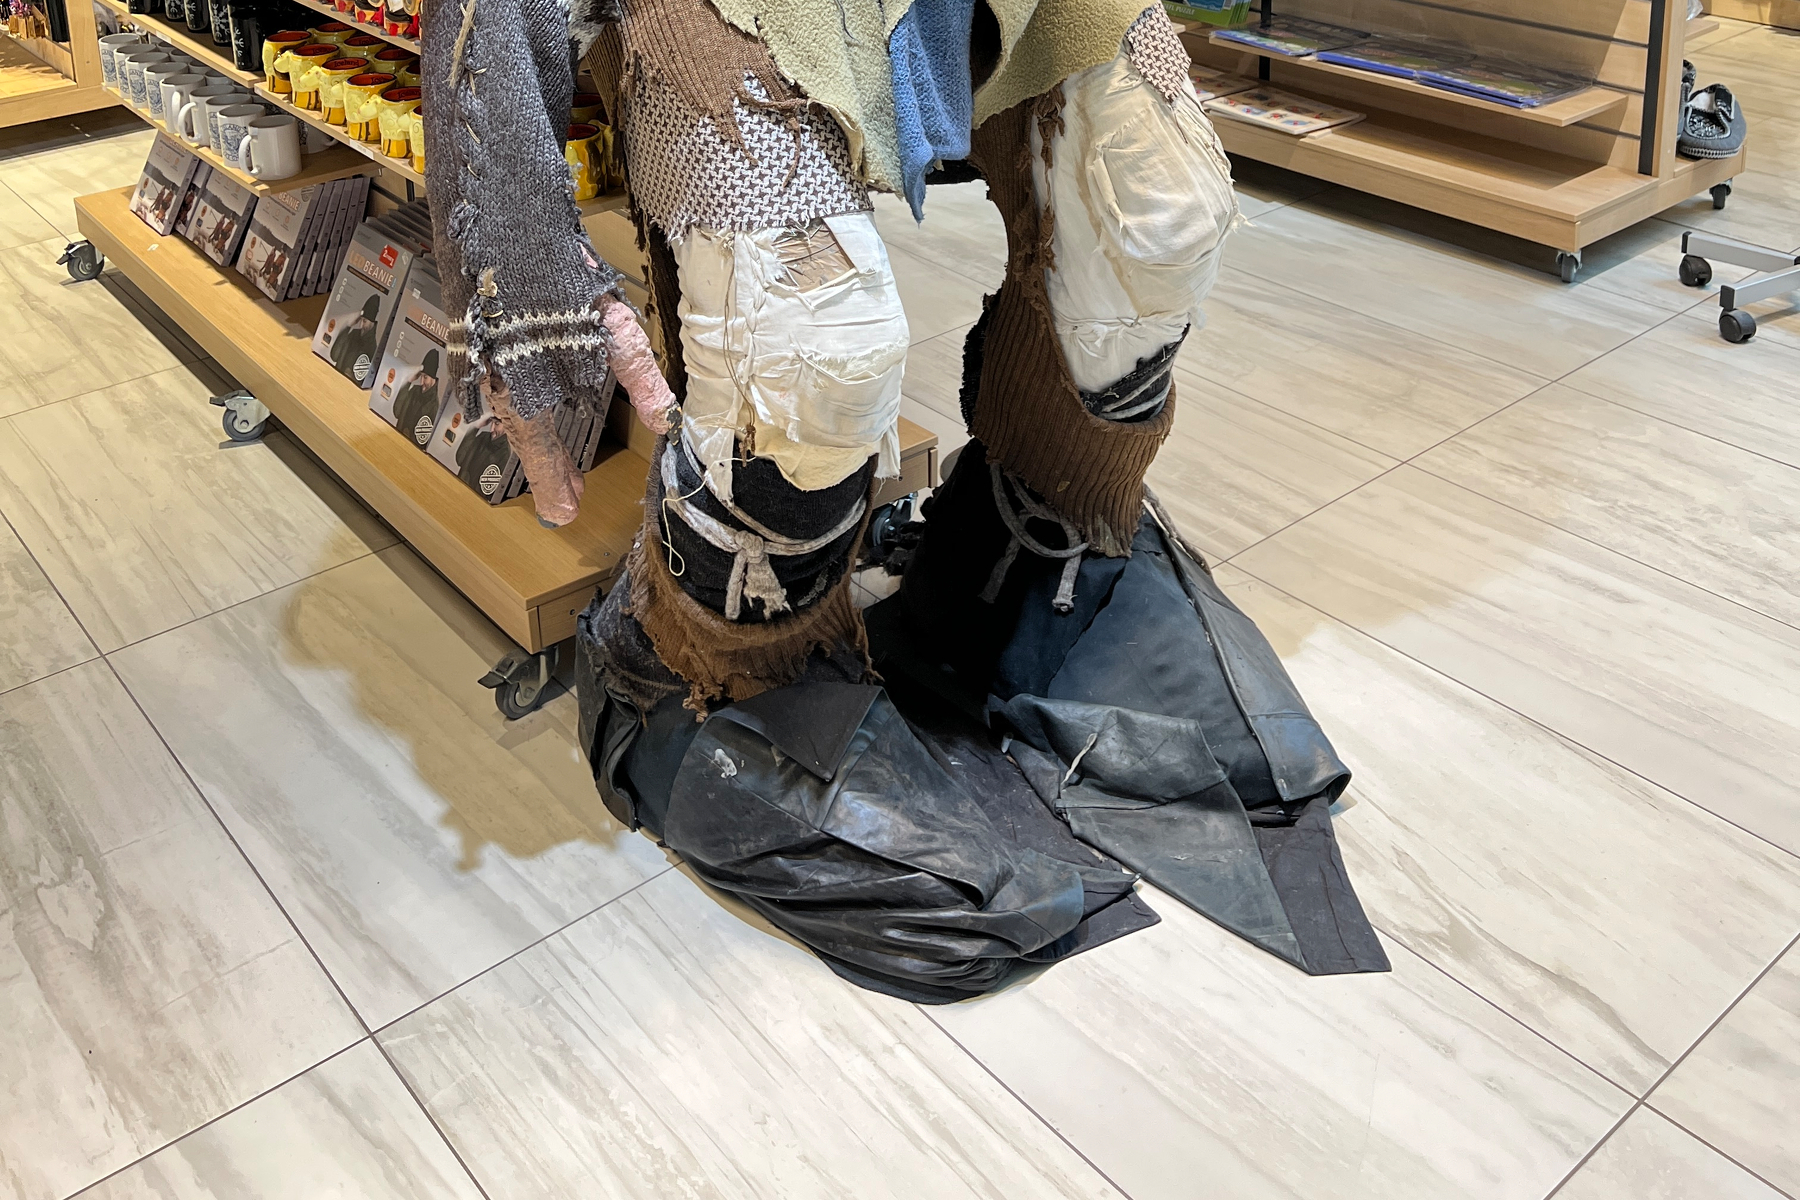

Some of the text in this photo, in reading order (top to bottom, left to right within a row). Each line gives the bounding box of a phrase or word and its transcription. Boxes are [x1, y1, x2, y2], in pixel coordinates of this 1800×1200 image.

[333, 60, 359, 68] Iceland
[278, 191, 300, 211] BEANIE
[421, 313, 450, 341] BEANIE
